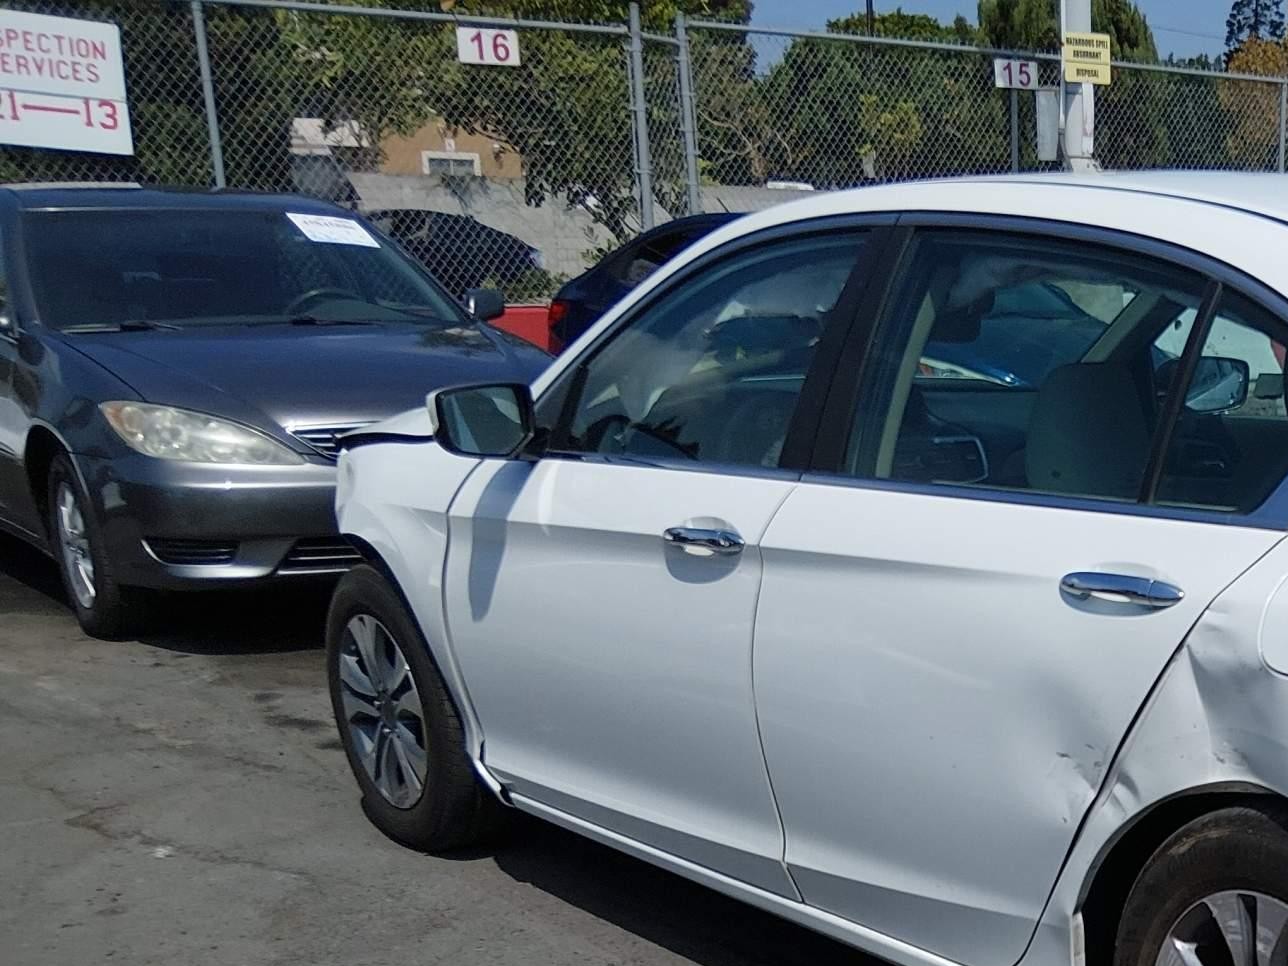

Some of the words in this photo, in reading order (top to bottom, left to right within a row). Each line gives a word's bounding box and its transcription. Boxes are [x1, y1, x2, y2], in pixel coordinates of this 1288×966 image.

[470, 31, 510, 62] 16
[1003, 62, 1031, 87] 15
[1076, 68, 1099, 78] DISPOSAL
